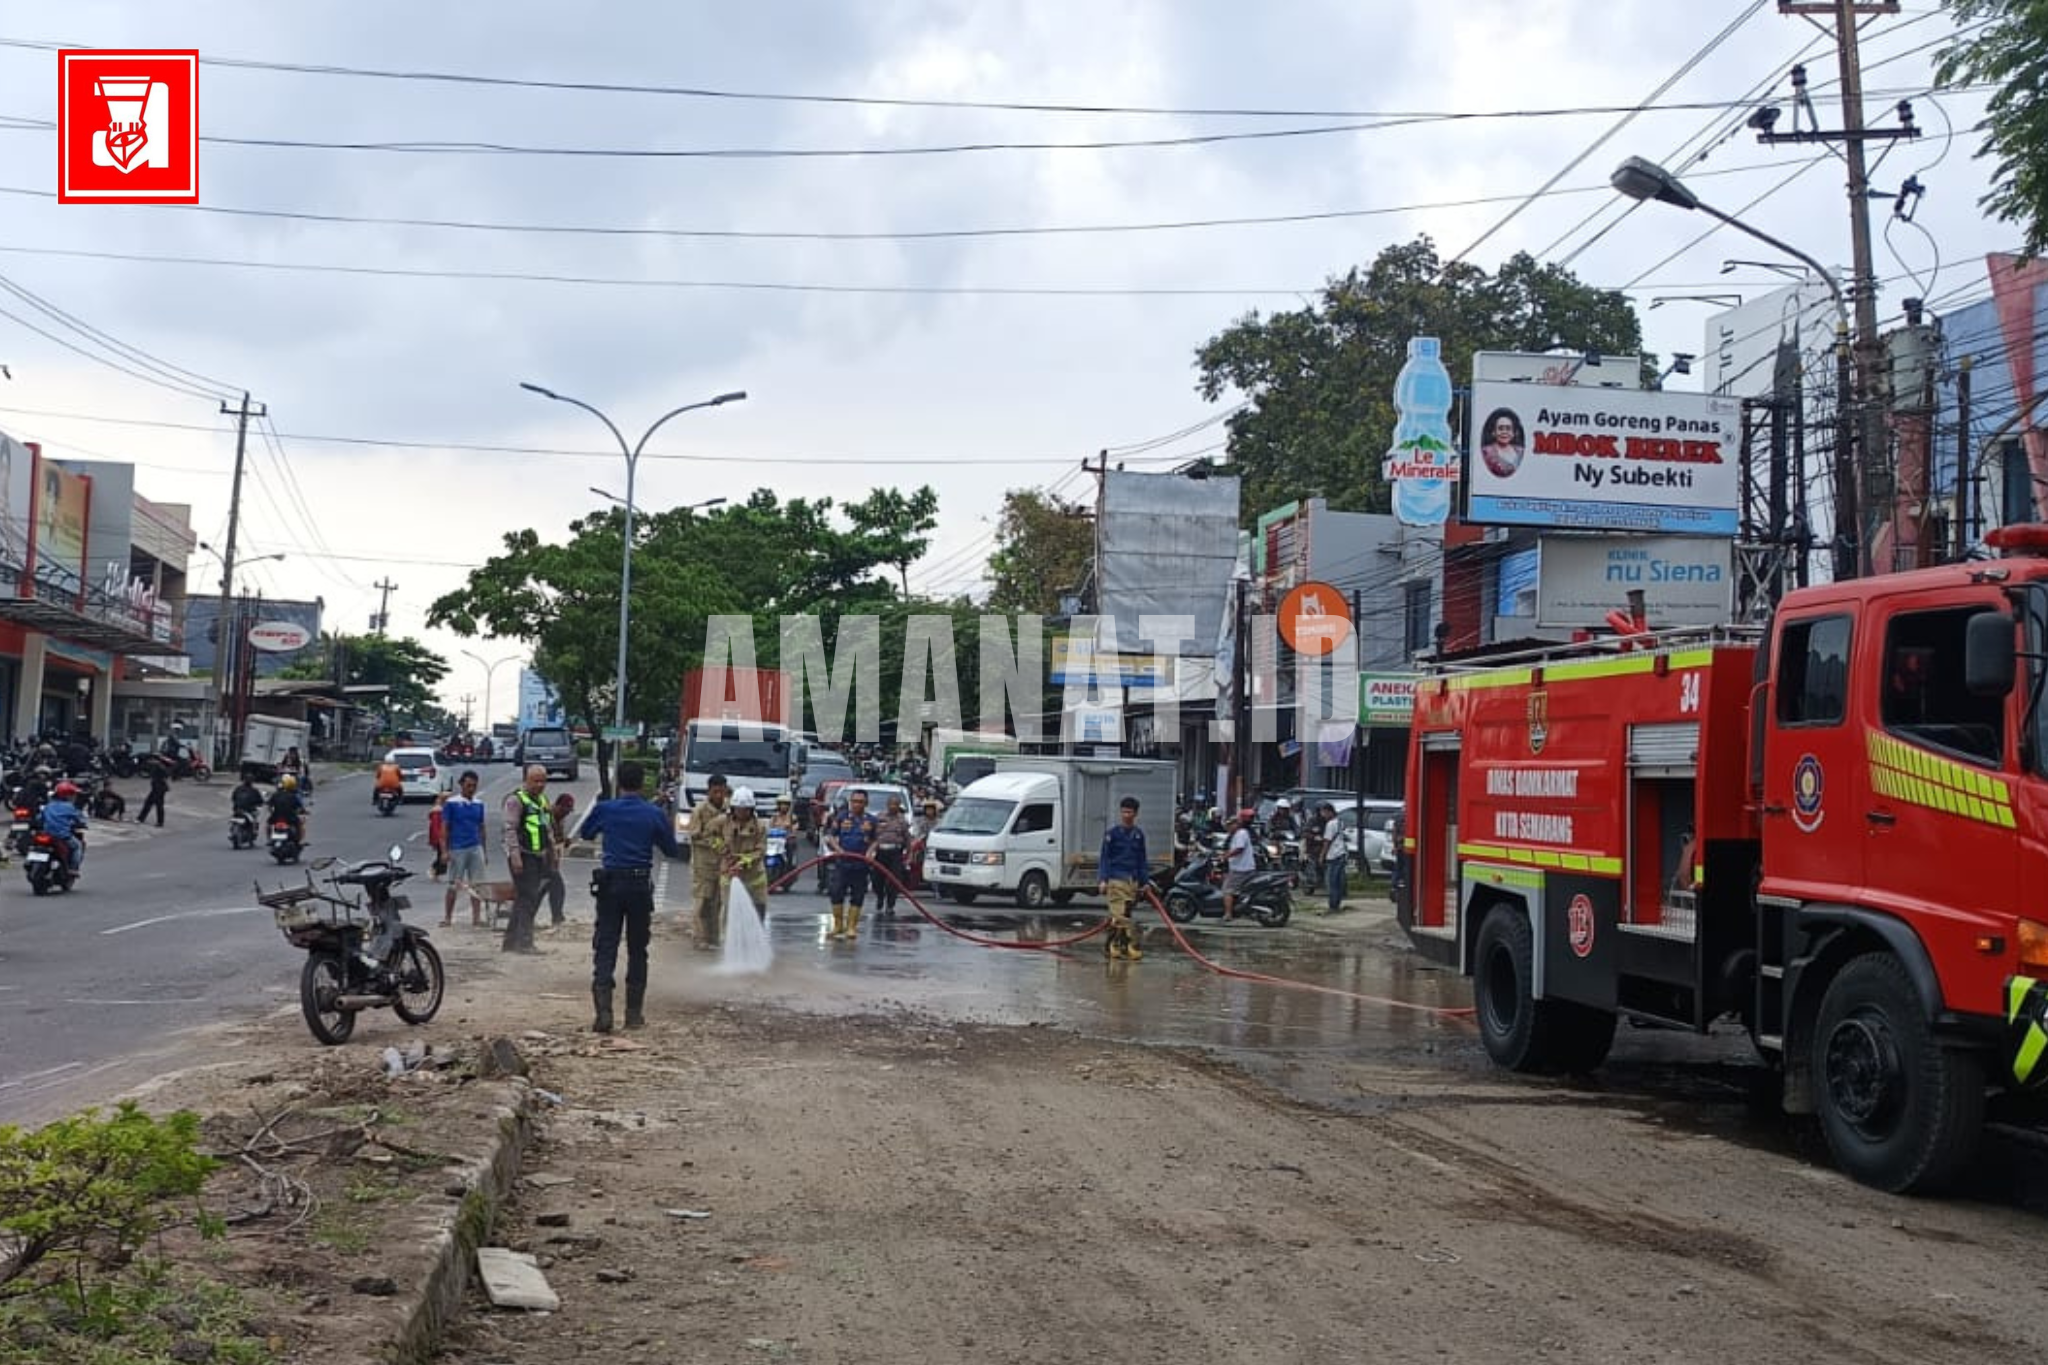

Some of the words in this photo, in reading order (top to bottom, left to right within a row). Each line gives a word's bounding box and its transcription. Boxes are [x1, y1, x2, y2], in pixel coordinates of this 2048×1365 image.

[1537, 408, 1590, 427] Ayam
[1594, 412, 1661, 432] Goreng
[1666, 416, 1721, 433] Panas
[1414, 447, 1433, 464] Le
[1533, 431, 1620, 458] MBOK
[1624, 436, 1724, 464] BEREK
[1389, 462, 1459, 478] Minerale
[1574, 463, 1604, 488] Ny
[1610, 465, 1693, 488] Subekti
[1606, 564, 1642, 581] nu
[1649, 561, 1721, 582] Siena
[1372, 696, 1415, 706] PLASTI
[1680, 672, 1700, 713] 34
